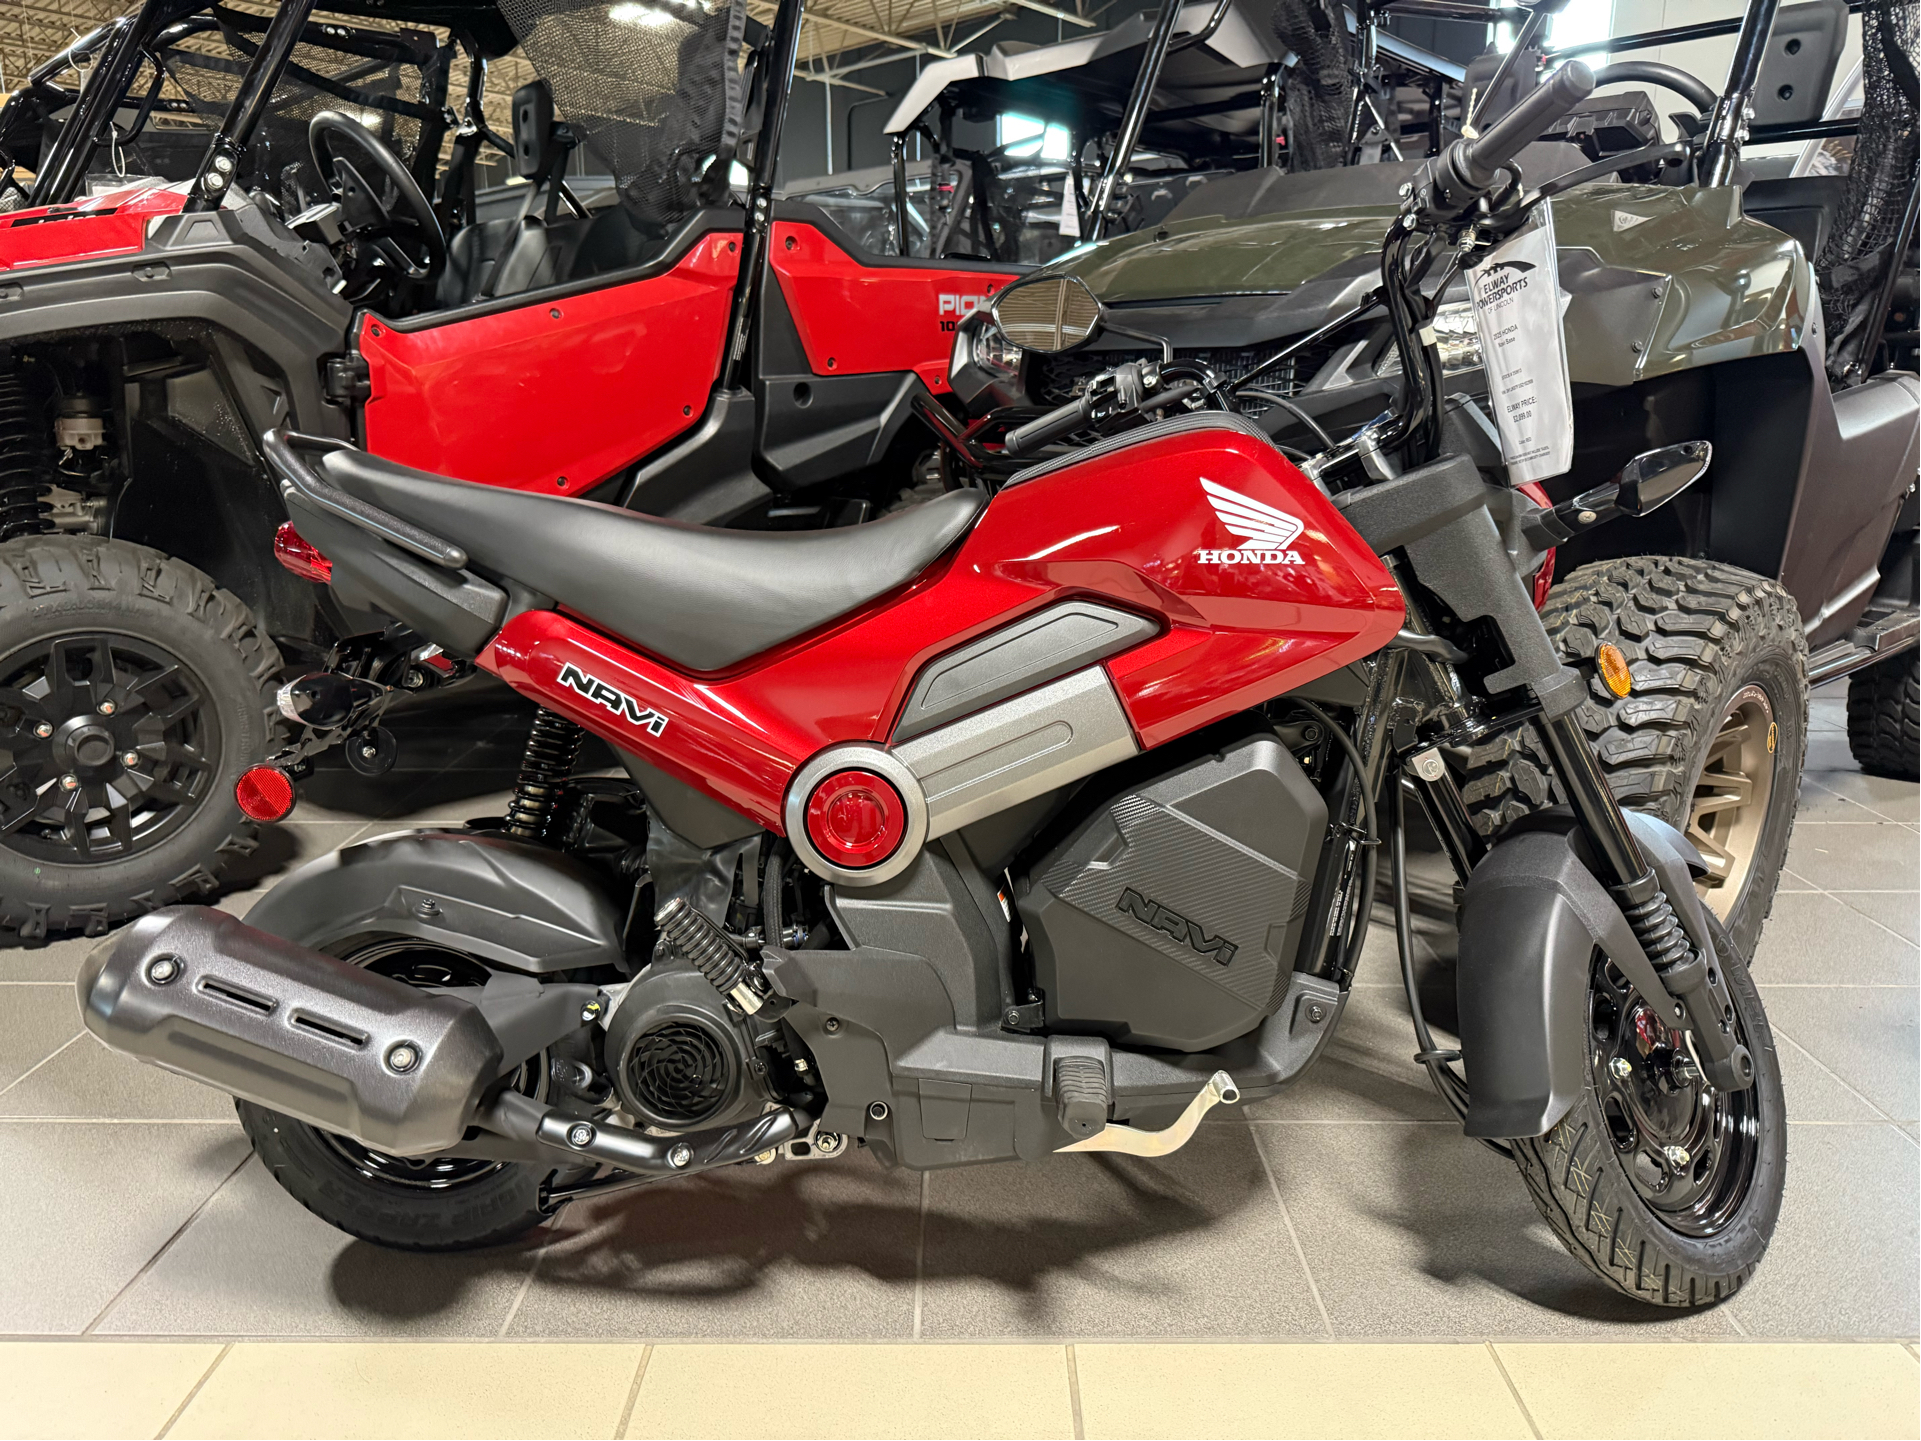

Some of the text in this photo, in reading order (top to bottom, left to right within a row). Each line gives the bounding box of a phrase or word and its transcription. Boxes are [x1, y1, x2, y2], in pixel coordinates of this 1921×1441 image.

[1484, 272, 1510, 294] ELWAY
[1476, 276, 1528, 311] POWERSPORTS
[1487, 296, 1514, 315] OF LINCOLN
[1502, 323, 1518, 336] HONDA
[1506, 395, 1537, 413] ELWAY PRICE:
[1197, 550, 1305, 565] HONDA
